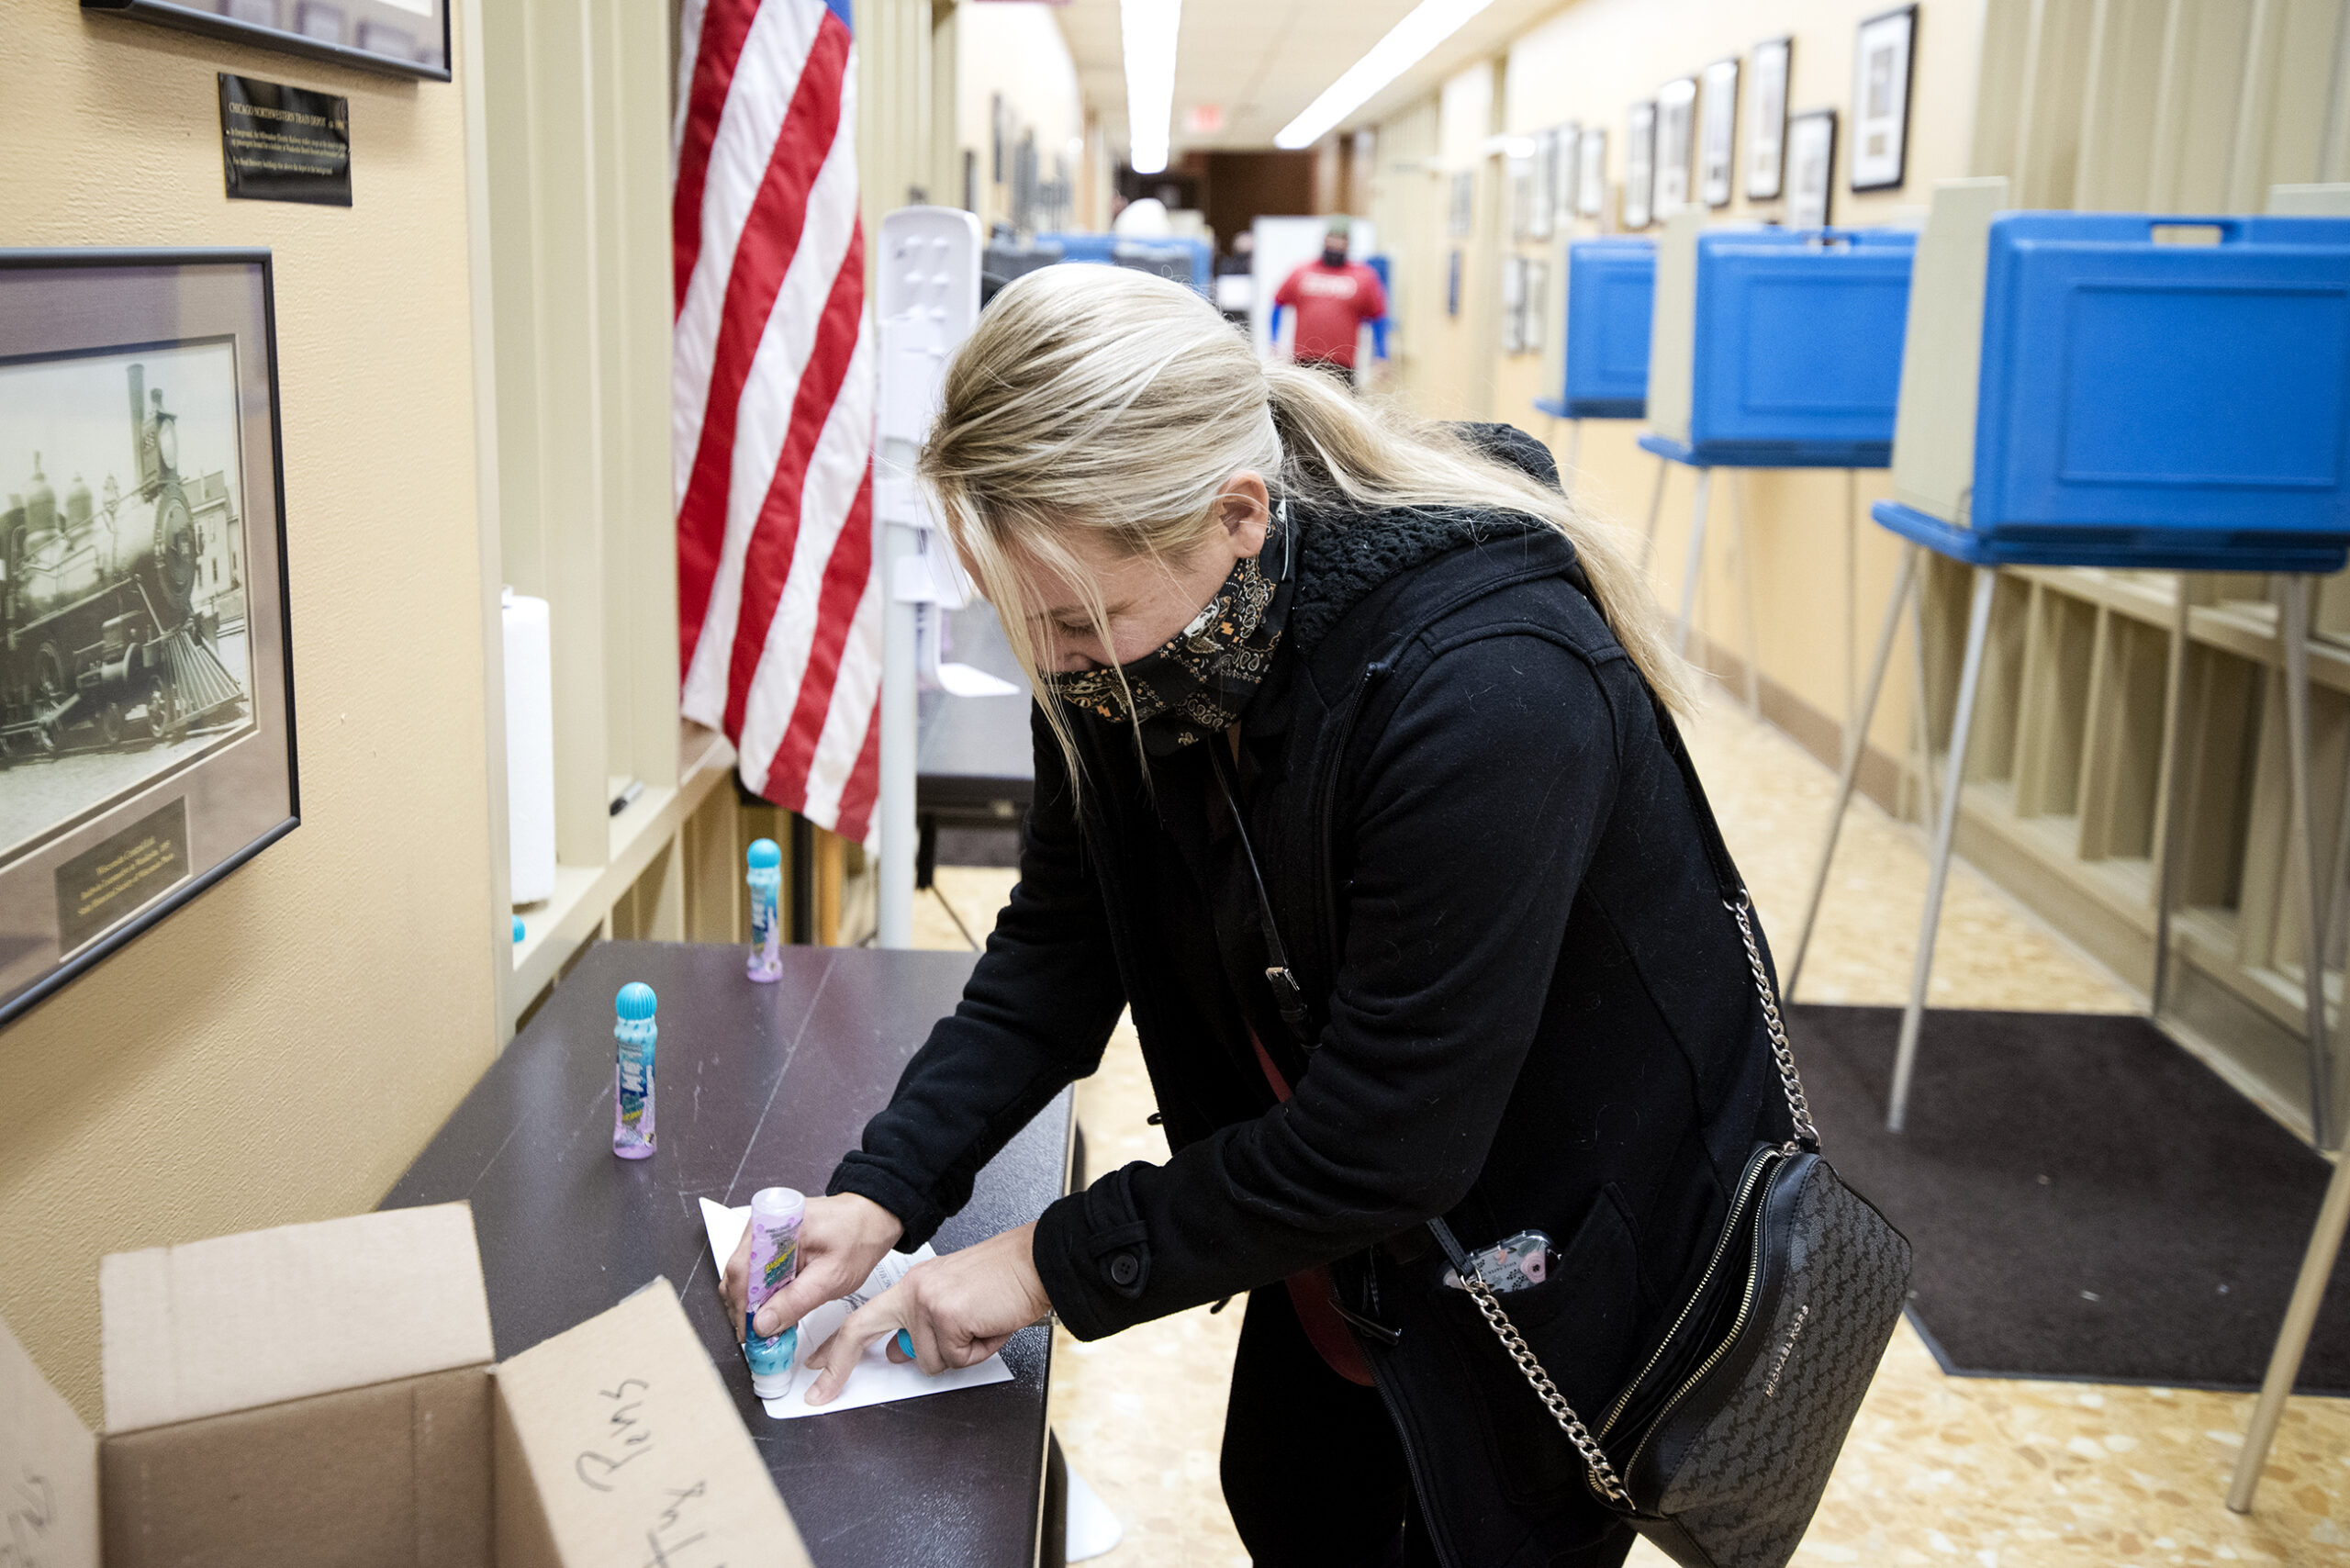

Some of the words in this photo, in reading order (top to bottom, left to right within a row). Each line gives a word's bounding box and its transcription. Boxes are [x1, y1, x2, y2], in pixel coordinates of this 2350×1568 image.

[229, 103, 253, 115] CHICAGO
[253, 106, 295, 122] NORTHWESTERN
[1765, 1342, 1794, 1397] MICHAEL
[1789, 1305, 1809, 1341] KORS
